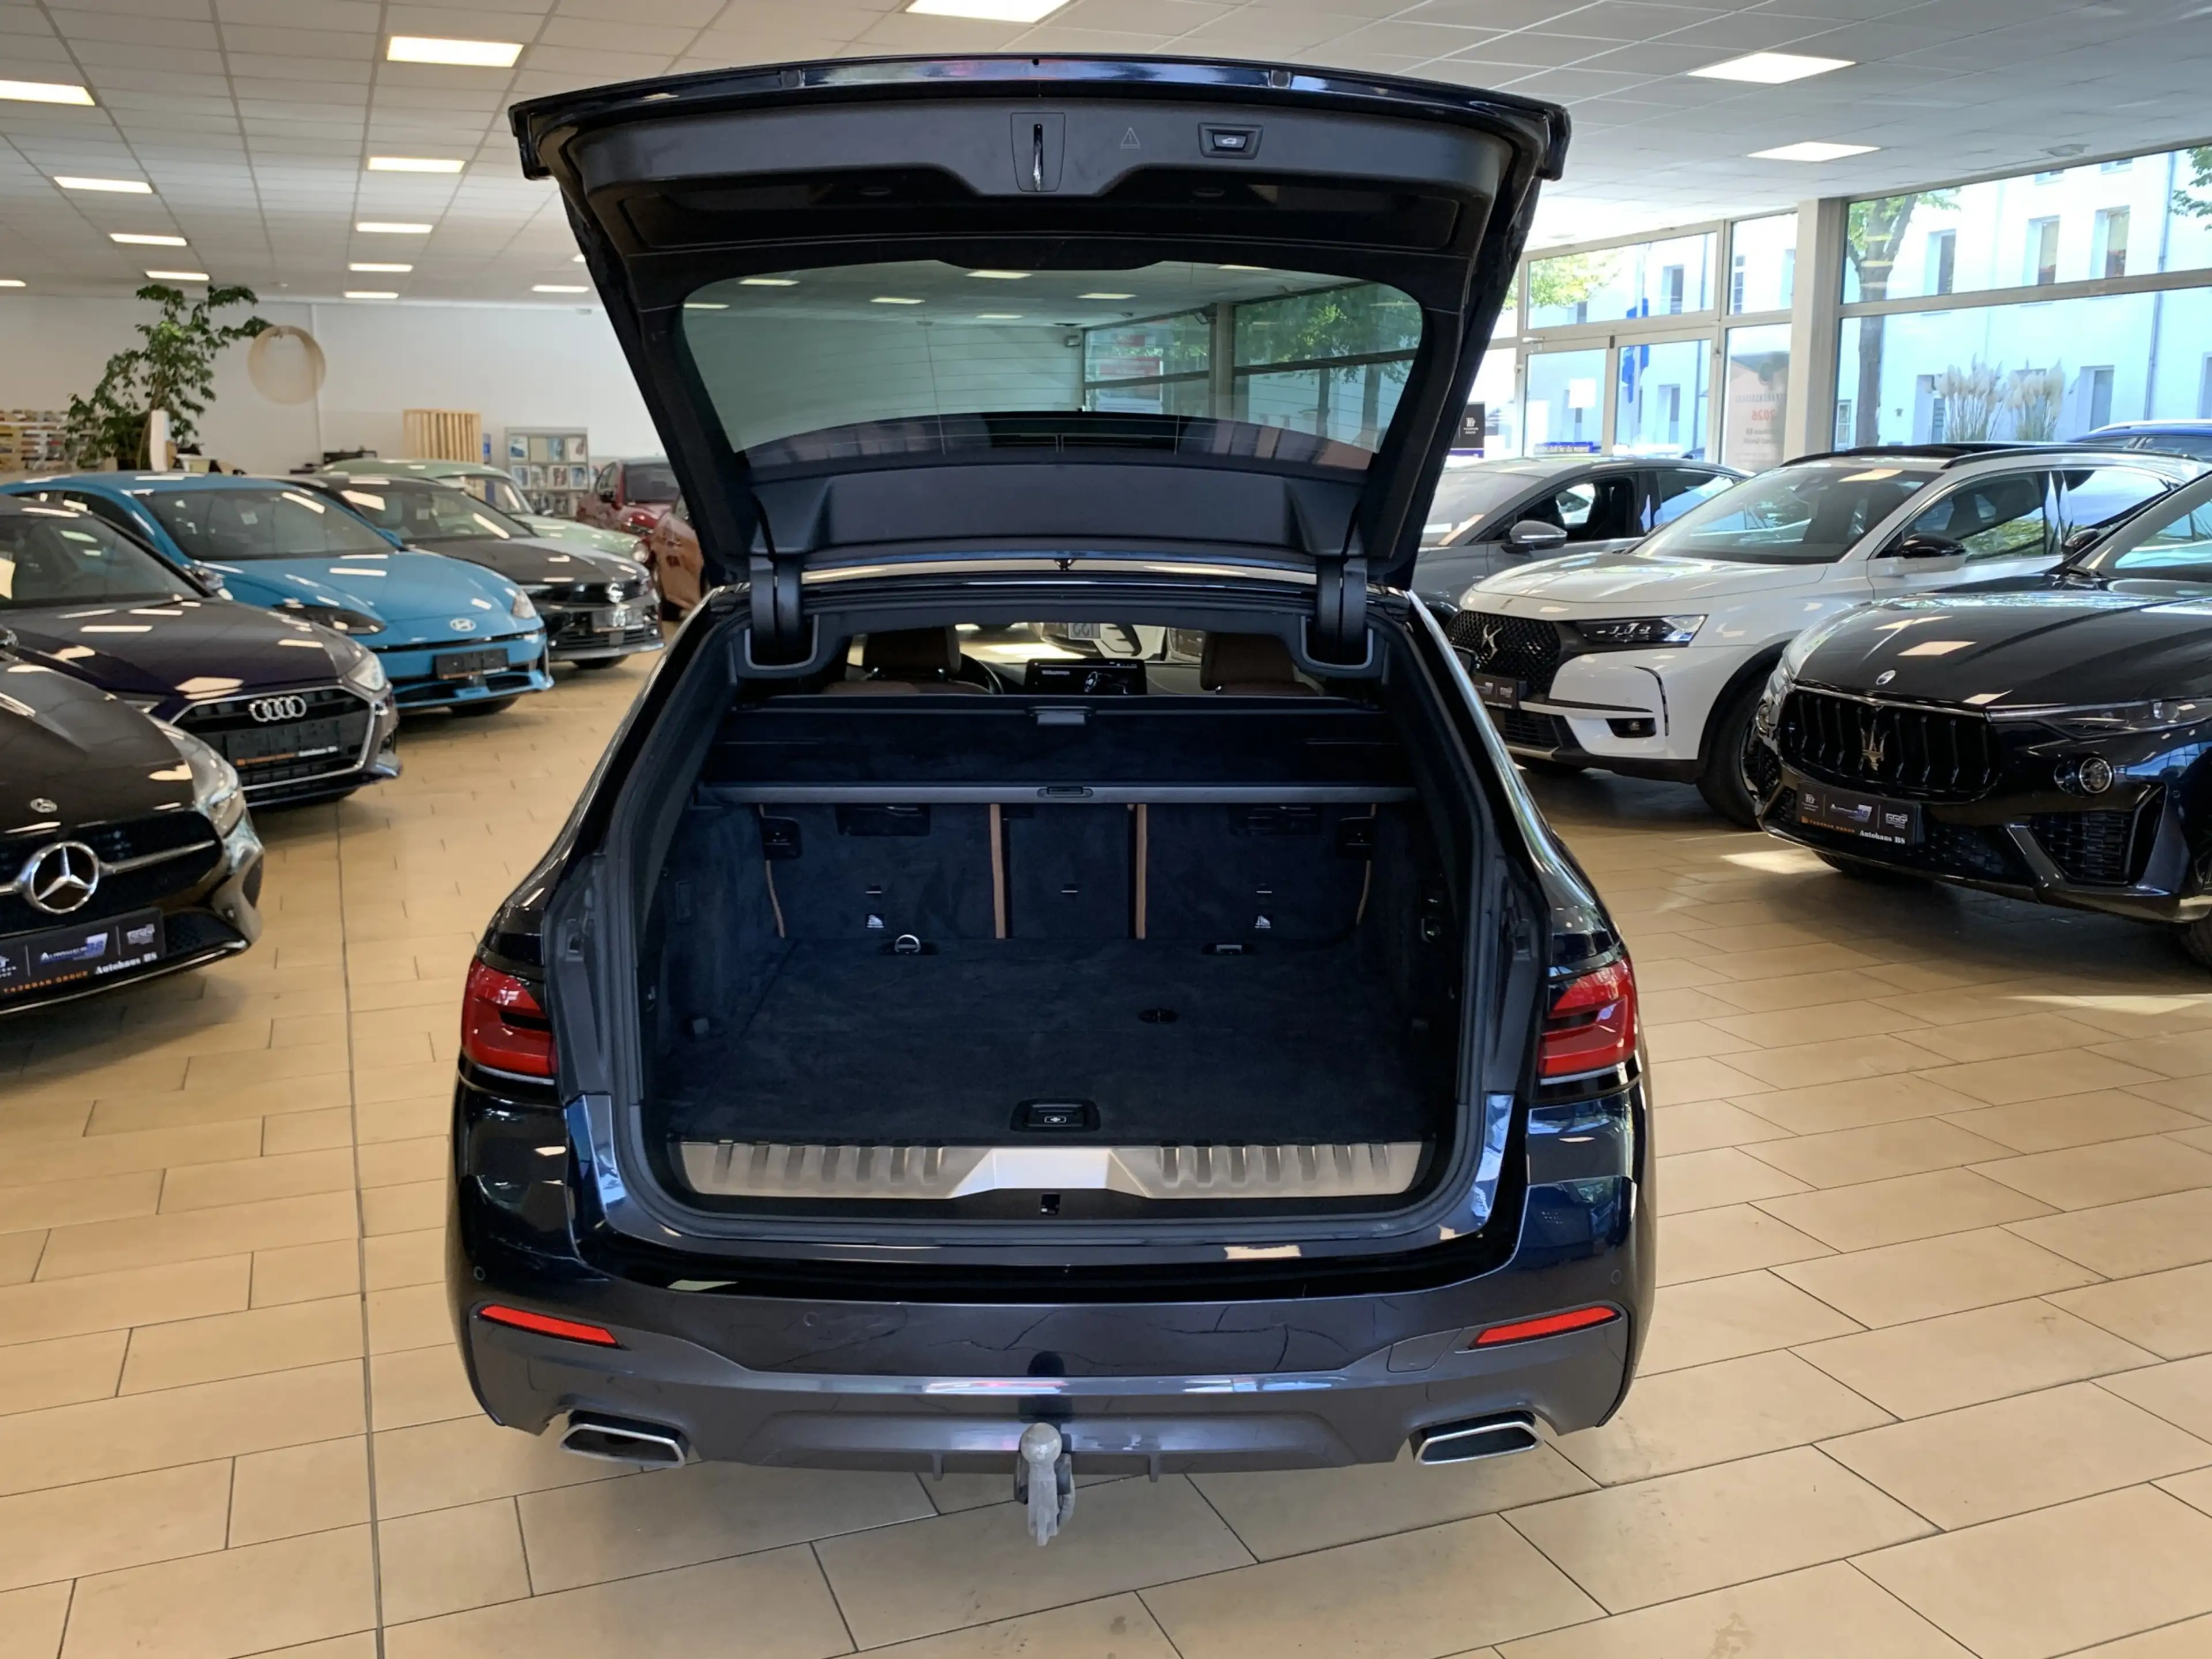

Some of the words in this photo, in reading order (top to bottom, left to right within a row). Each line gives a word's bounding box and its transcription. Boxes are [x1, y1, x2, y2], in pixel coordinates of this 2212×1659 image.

[1859, 830, 1893, 842] Autohaus
[1895, 836, 1906, 844] BS
[94, 957, 141, 974] Autohaus
